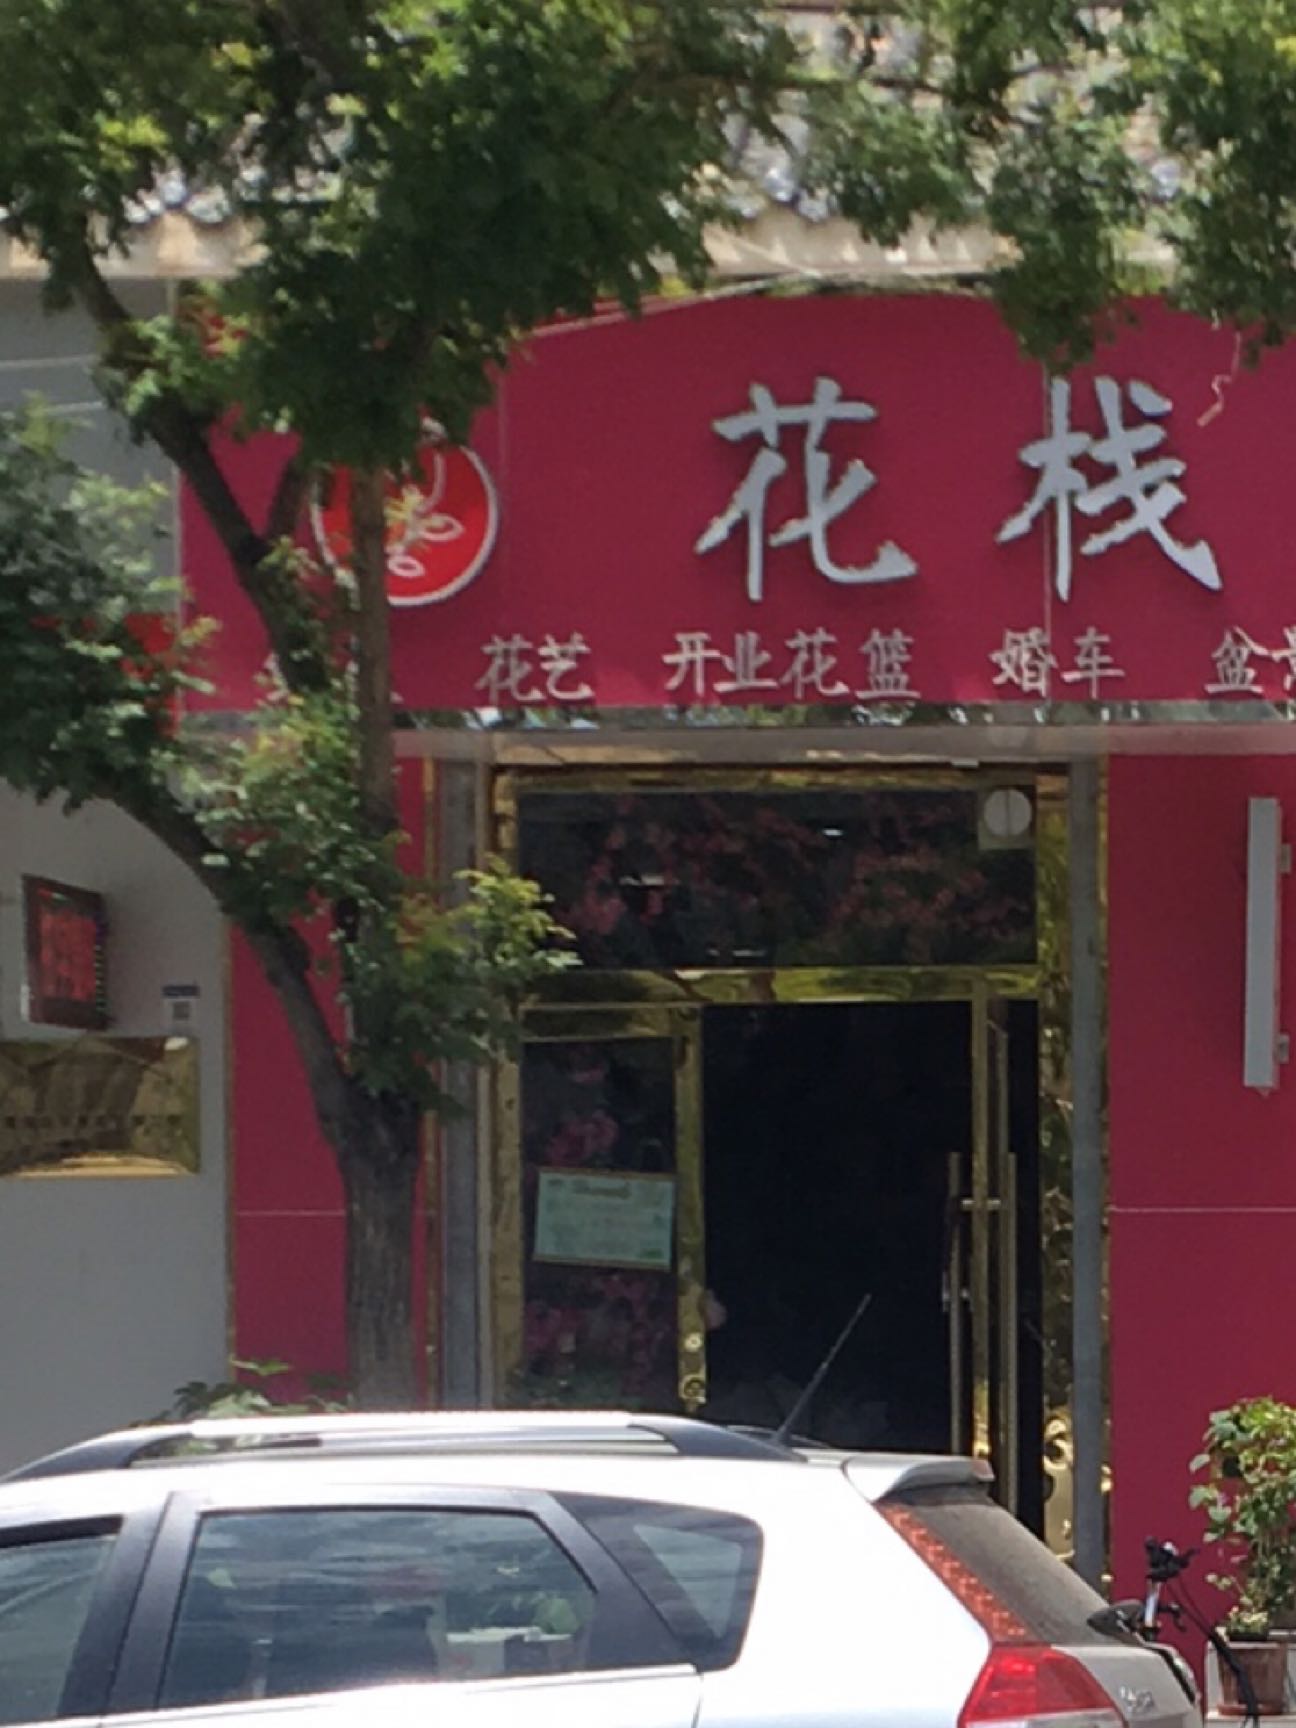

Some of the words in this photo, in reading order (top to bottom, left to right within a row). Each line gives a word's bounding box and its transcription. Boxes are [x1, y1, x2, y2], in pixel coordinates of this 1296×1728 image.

[696, 376, 1222, 602] 花栈
[477, 633, 595, 704] 花艺
[661, 627, 921, 706] 开业花篮
[989, 627, 1126, 702] 婚车
